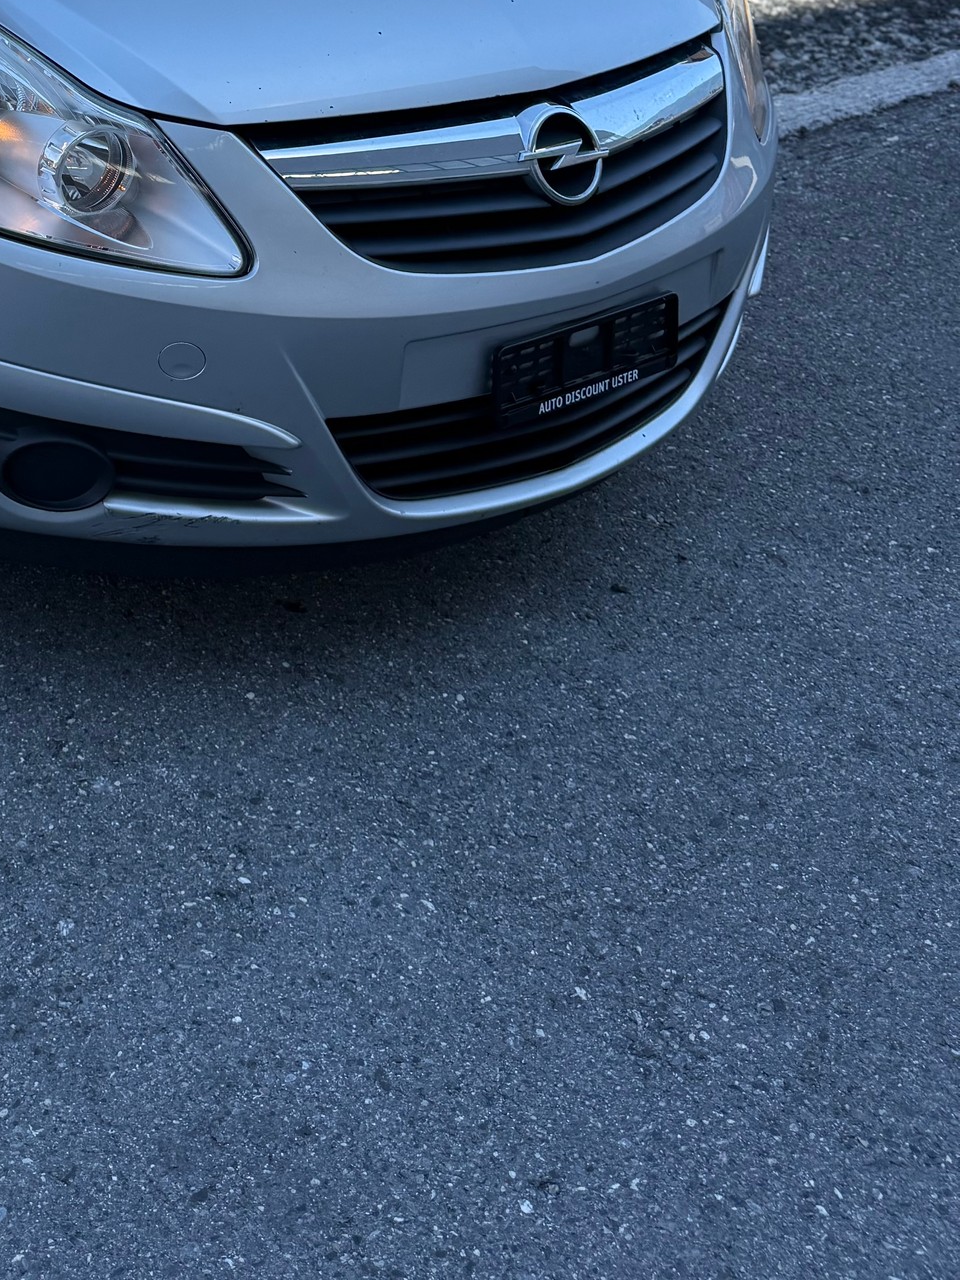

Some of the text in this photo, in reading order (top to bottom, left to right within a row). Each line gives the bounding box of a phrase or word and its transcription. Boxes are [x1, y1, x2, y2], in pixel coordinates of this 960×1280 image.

[539, 369, 639, 415] AUTO DISCOUNT USTER
